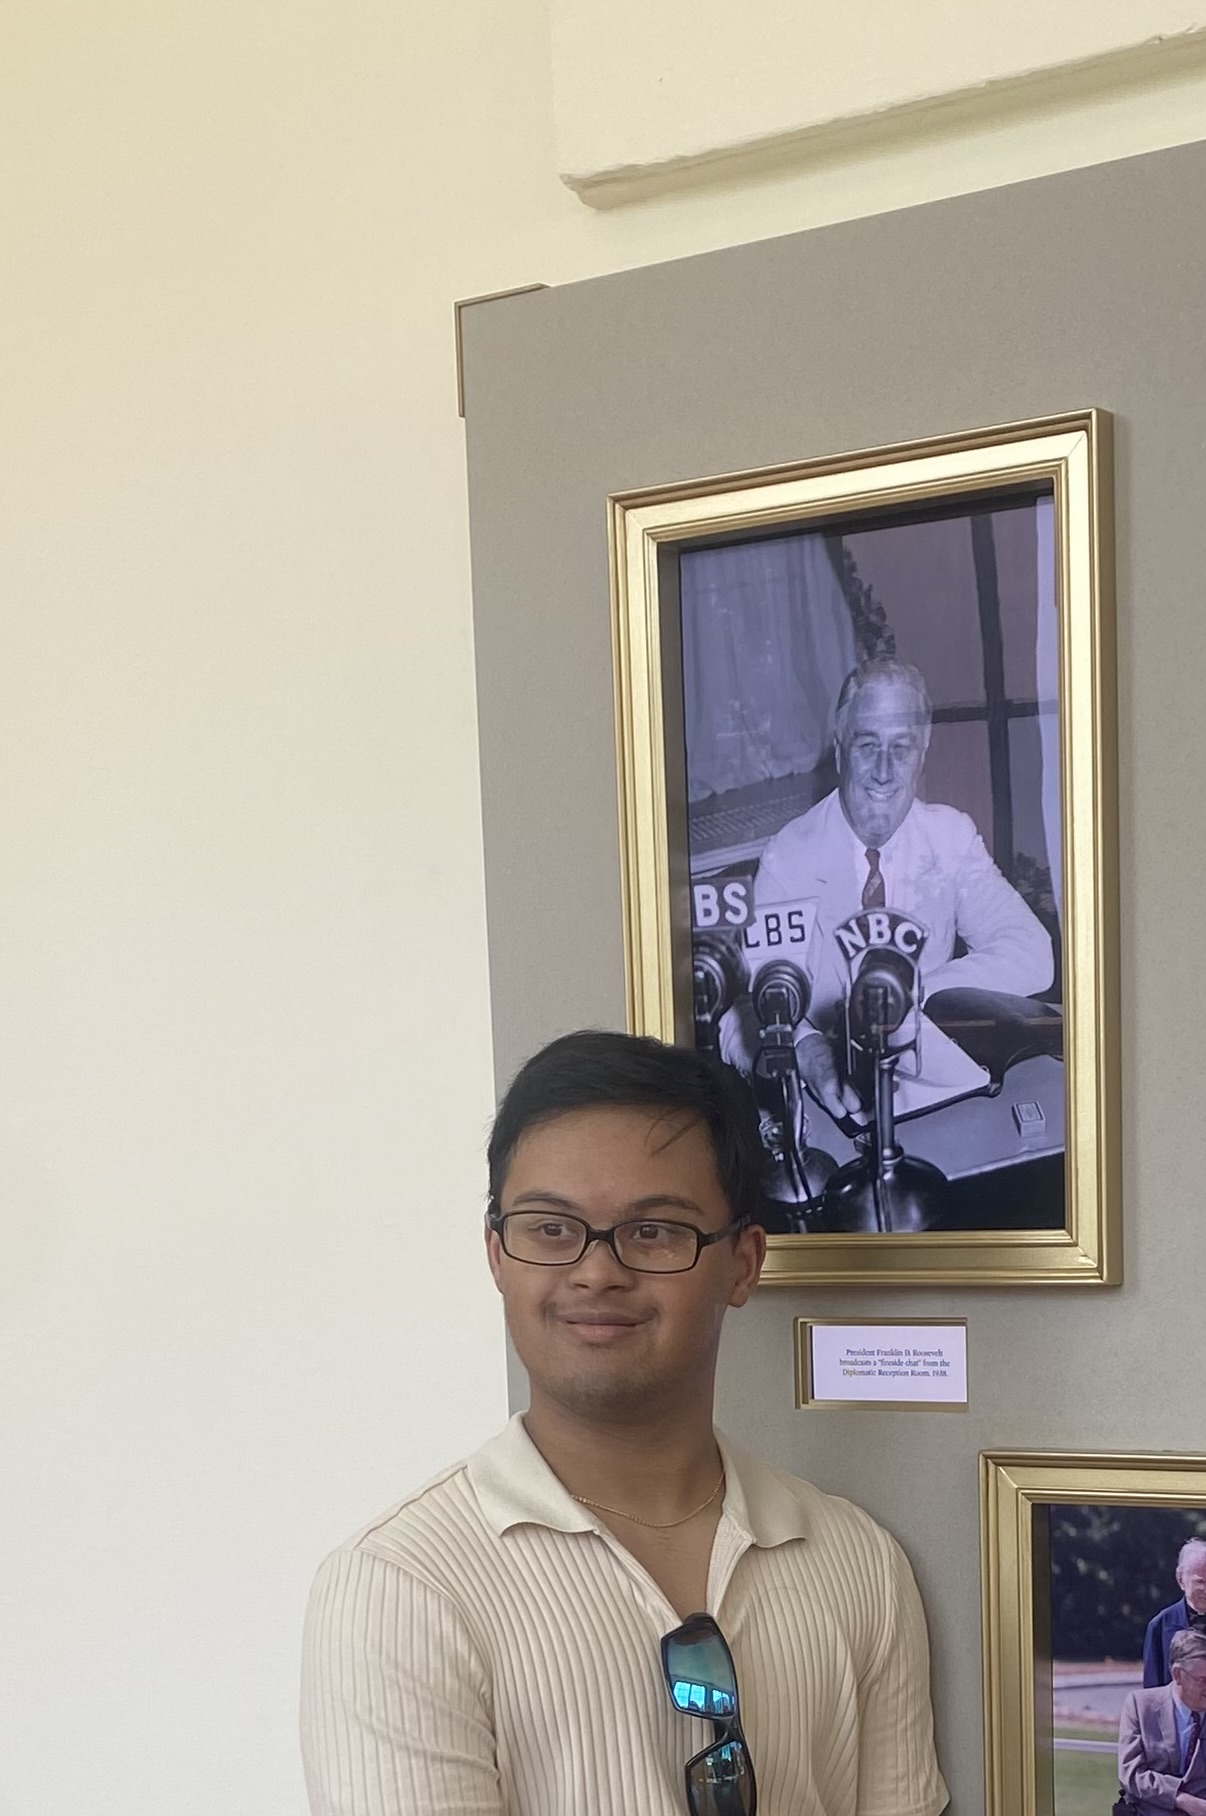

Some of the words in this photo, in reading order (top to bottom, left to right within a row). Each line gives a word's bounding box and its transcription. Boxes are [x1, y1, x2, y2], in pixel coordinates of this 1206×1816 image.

[835, 913, 923, 956] NBC
[923, 1359, 938, 1367] from
[842, 1369, 876, 1377] Diplomatic
[878, 1369, 909, 1377] Reception
